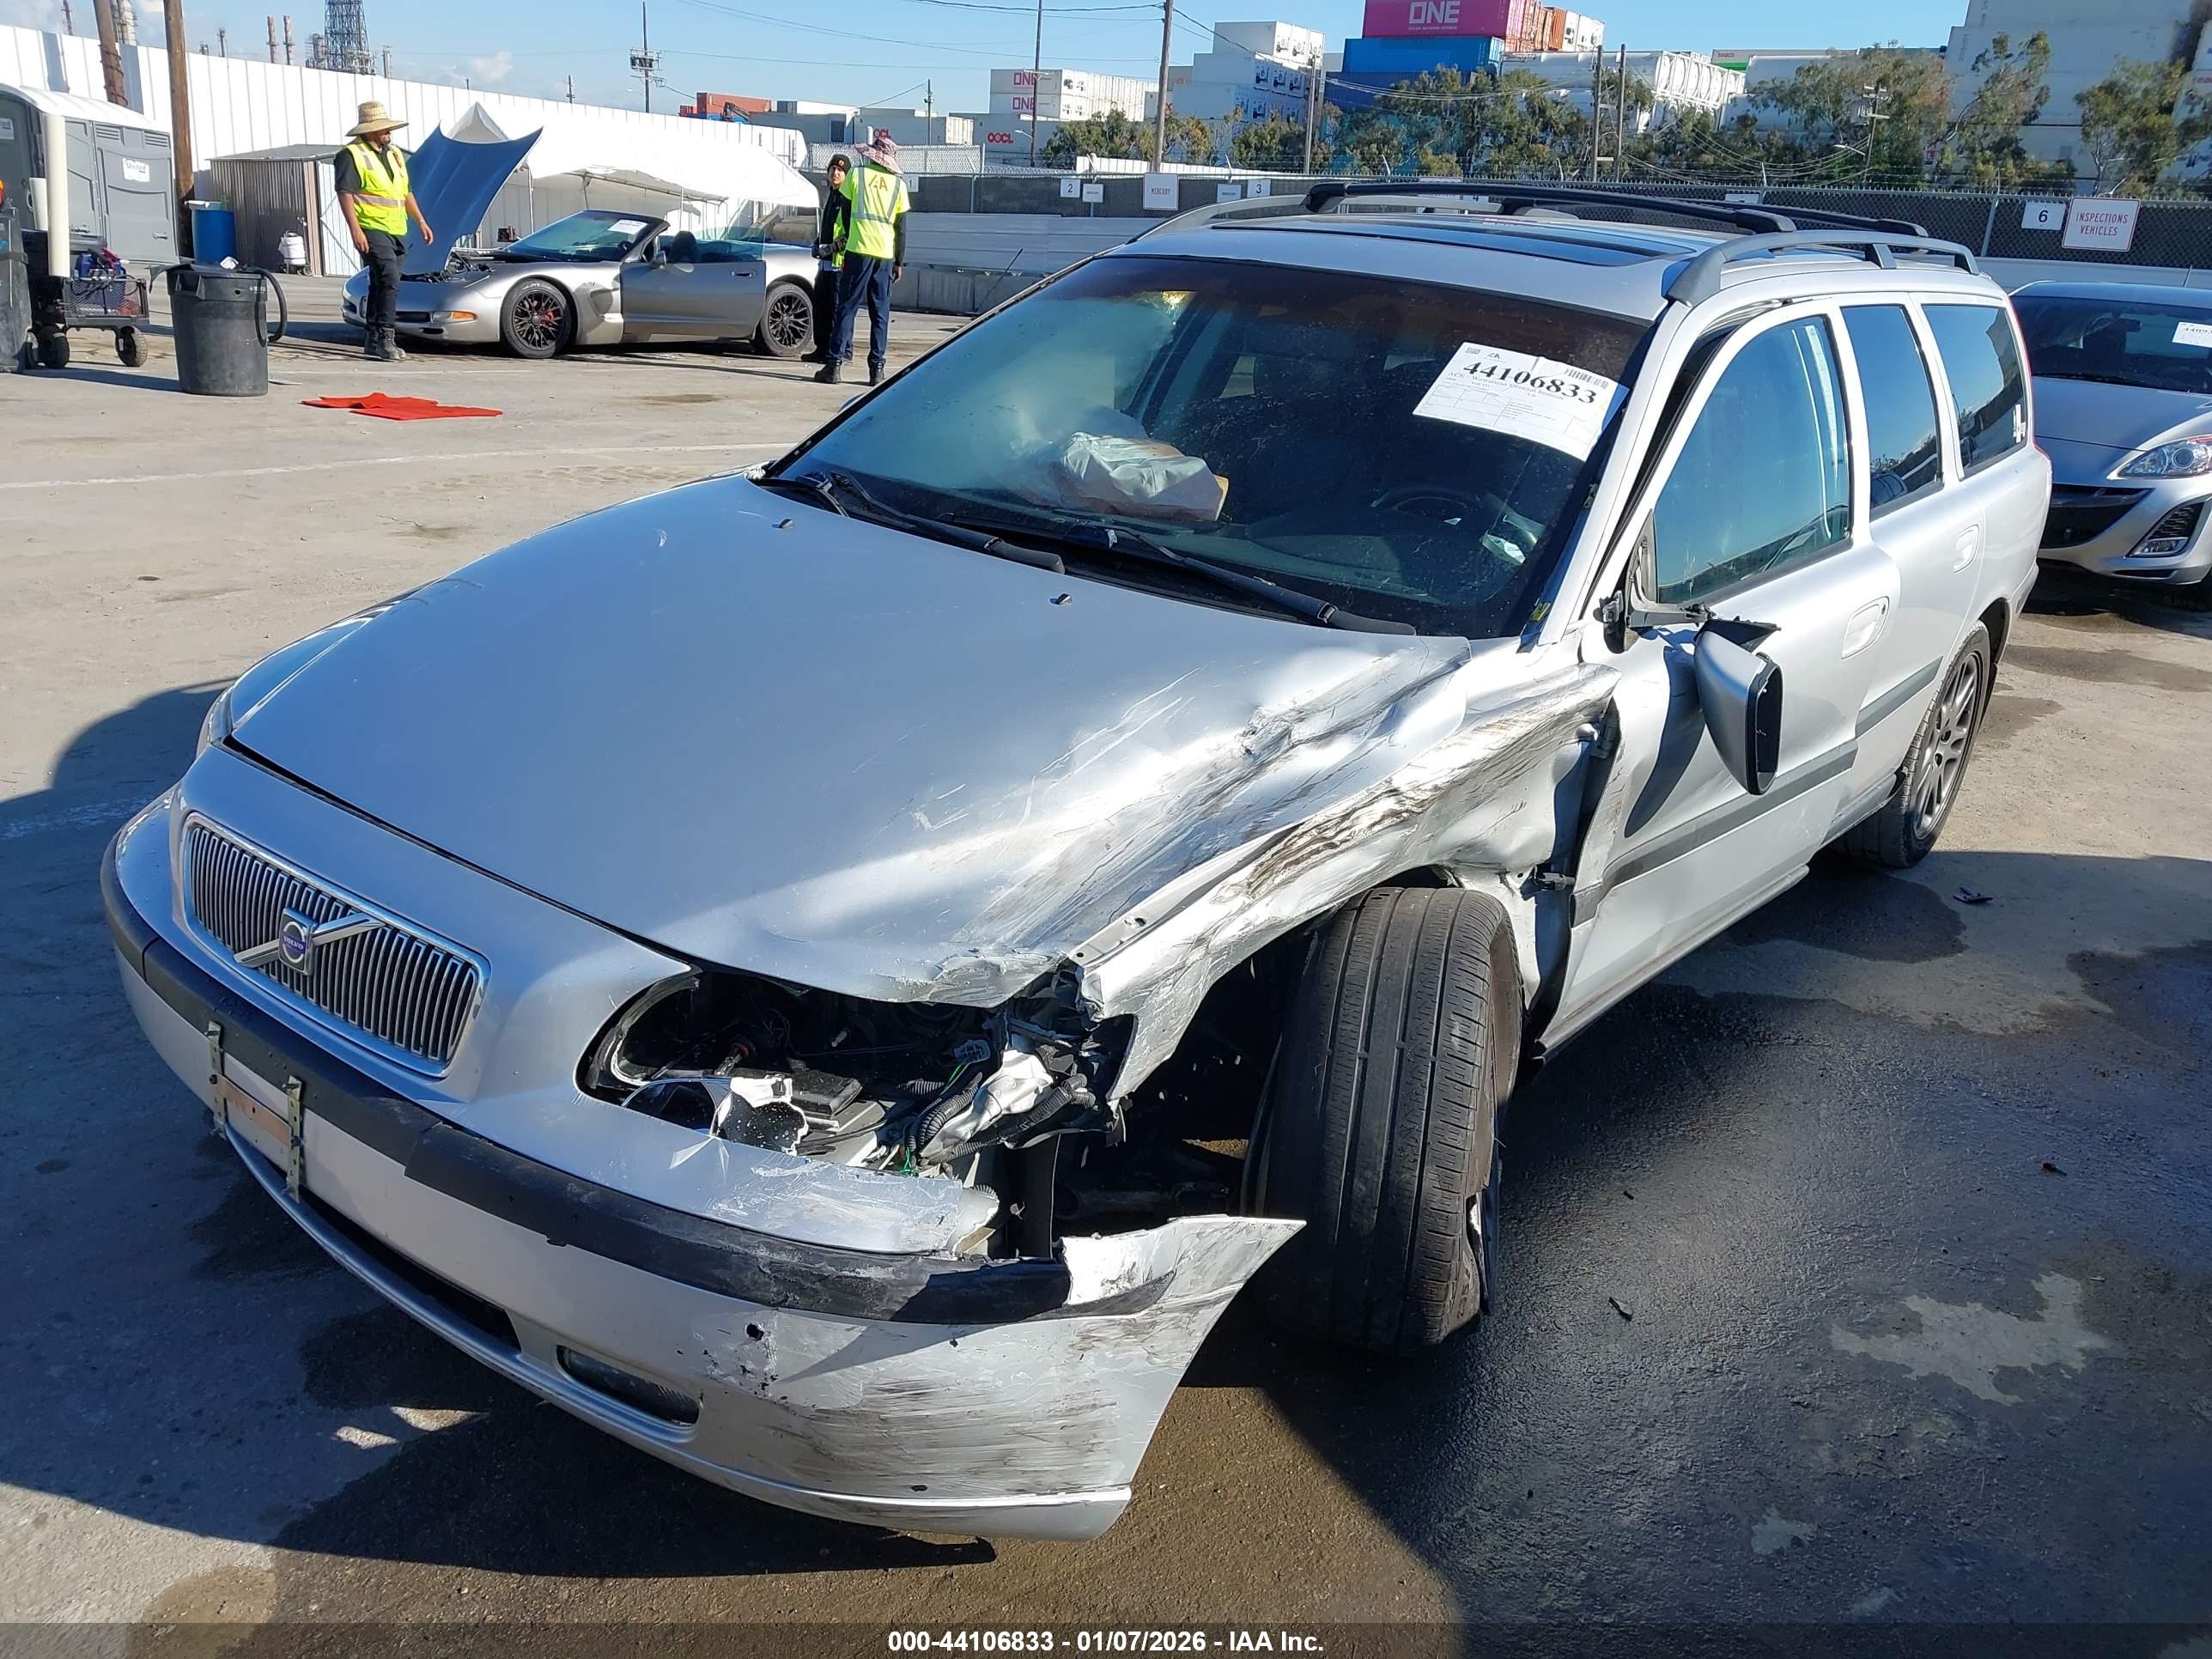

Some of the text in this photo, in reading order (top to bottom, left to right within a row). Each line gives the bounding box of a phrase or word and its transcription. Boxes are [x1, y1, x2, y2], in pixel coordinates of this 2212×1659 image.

[1409, 1, 1461, 24] ONE
[988, 132, 1014, 143] OOCL
[126, 162, 146, 172] United
[1067, 183, 1073, 193] 2
[1255, 184, 1262, 194] 3
[2038, 210, 2050, 223] 6
[2075, 212, 2129, 224] INSPECTIONS
[2080, 224, 2118, 236] VEHICLES
[1462, 361, 1597, 404] 44106833
[283, 935, 304, 950] VOLVO
